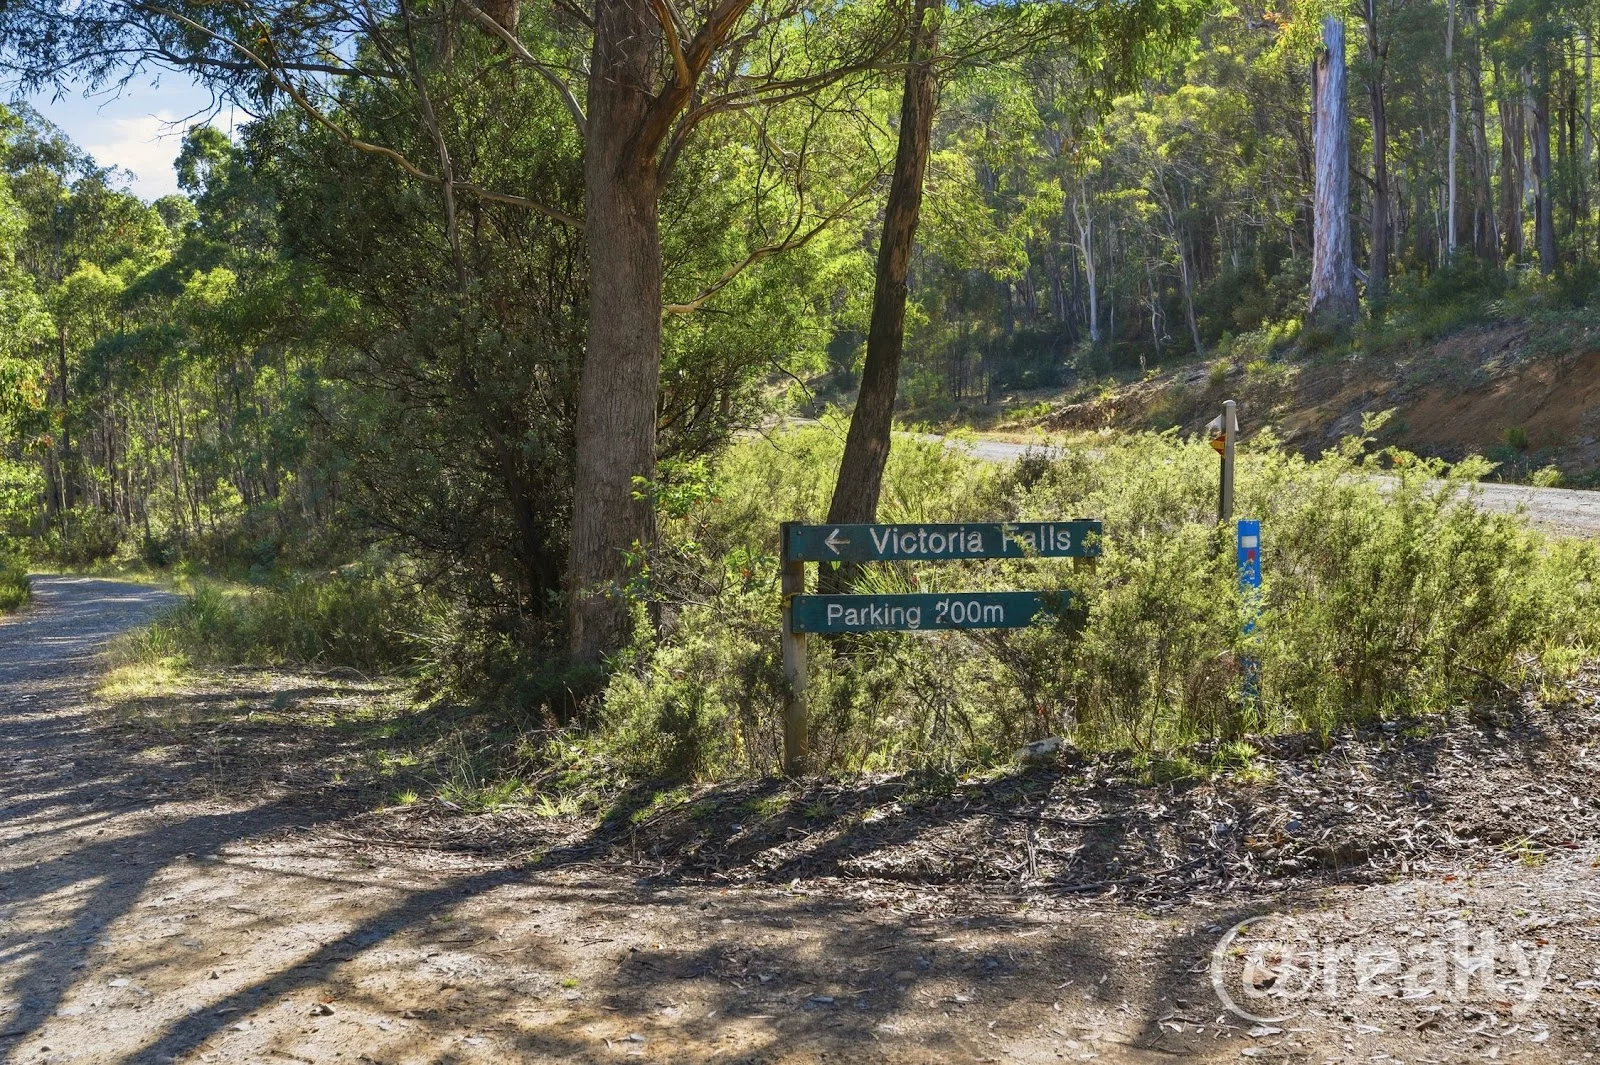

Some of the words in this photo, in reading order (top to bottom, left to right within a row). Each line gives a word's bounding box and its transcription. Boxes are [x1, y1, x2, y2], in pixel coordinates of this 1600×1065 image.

[869, 526, 984, 554] Victoria
[827, 603, 921, 629] Parking
[935, 598, 1004, 624] 200m
